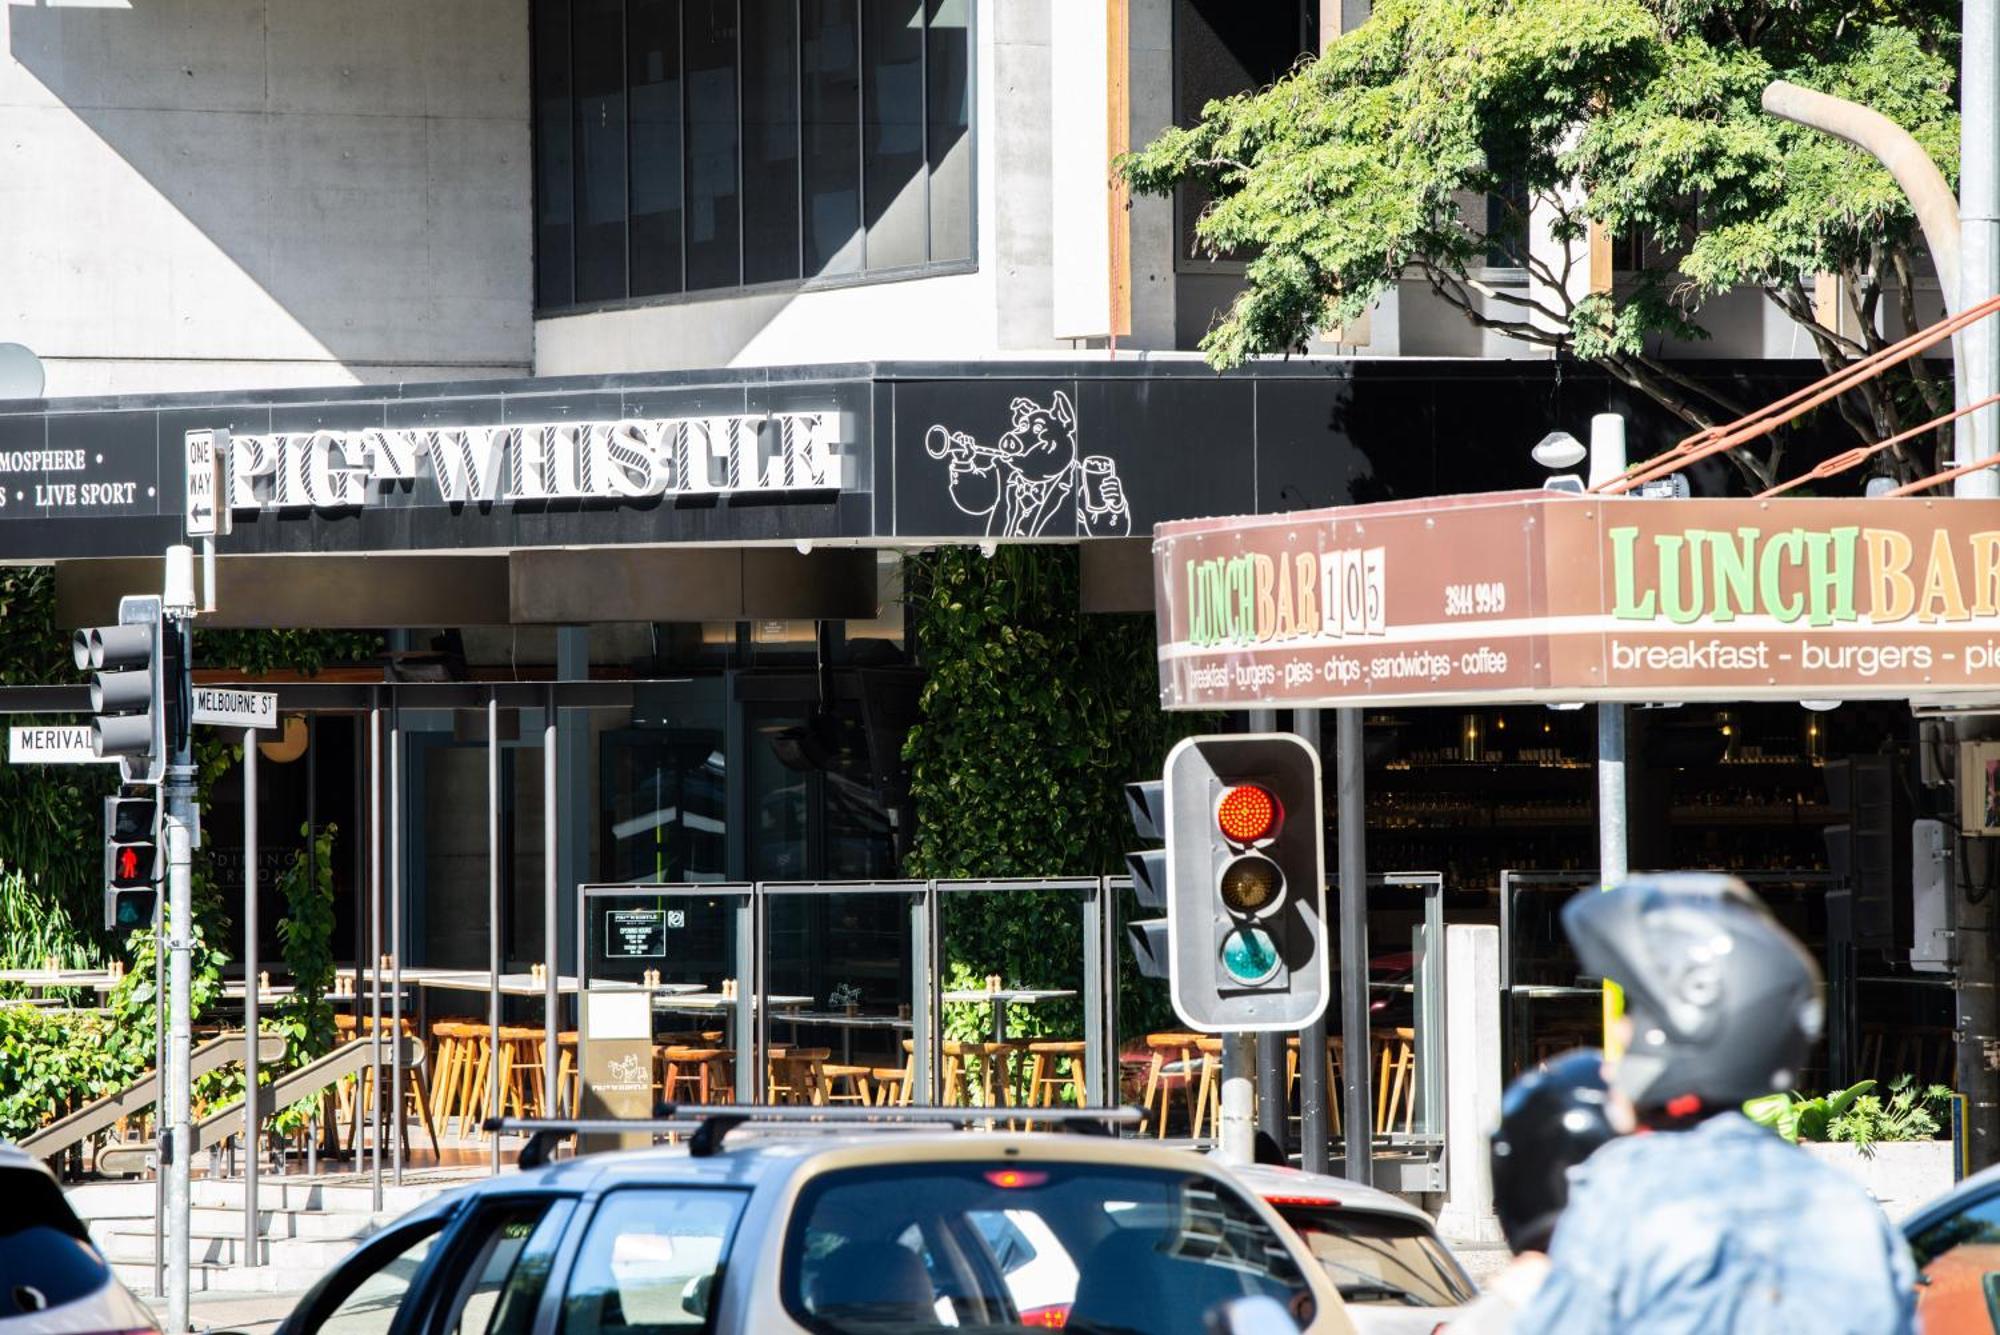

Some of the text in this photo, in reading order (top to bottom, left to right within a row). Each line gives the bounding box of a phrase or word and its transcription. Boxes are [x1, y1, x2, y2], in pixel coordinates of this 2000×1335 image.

[190, 441, 209, 465] ONE
[229, 431, 369, 507] PIG
[427, 411, 840, 503] WHISTLE
[35, 484, 77, 506] LIVE
[81, 482, 136, 505] SPORT
[190, 472, 212, 496] WAY
[1609, 526, 1860, 628] LUNCH
[1187, 551, 1382, 648] LUNCH BAR 105
[1190, 646, 1507, 692] breakfast burgers pies chips sandwiches coffee
[1612, 640, 1770, 670] breakfast
[1802, 640, 1933, 676] burgers
[198, 691, 272, 715] MELBOURNE ST
